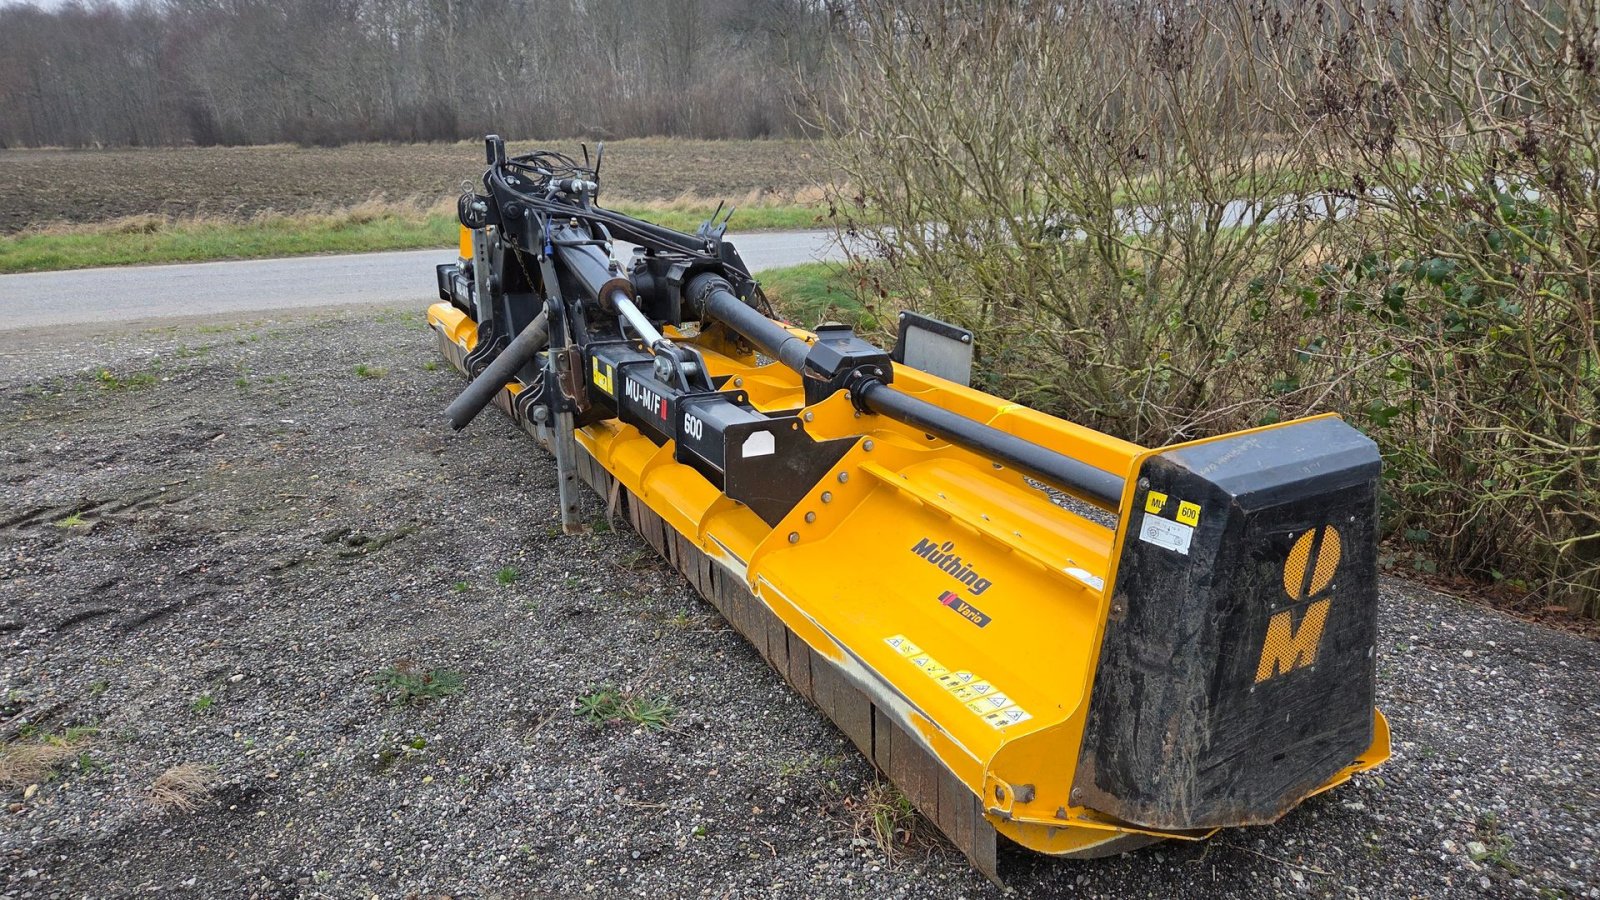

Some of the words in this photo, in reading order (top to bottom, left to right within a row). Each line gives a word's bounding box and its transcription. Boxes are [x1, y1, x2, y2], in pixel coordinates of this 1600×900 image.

[684, 413, 702, 440] 600
[1182, 506, 1196, 519] 600
[957, 602, 982, 624] Vario
